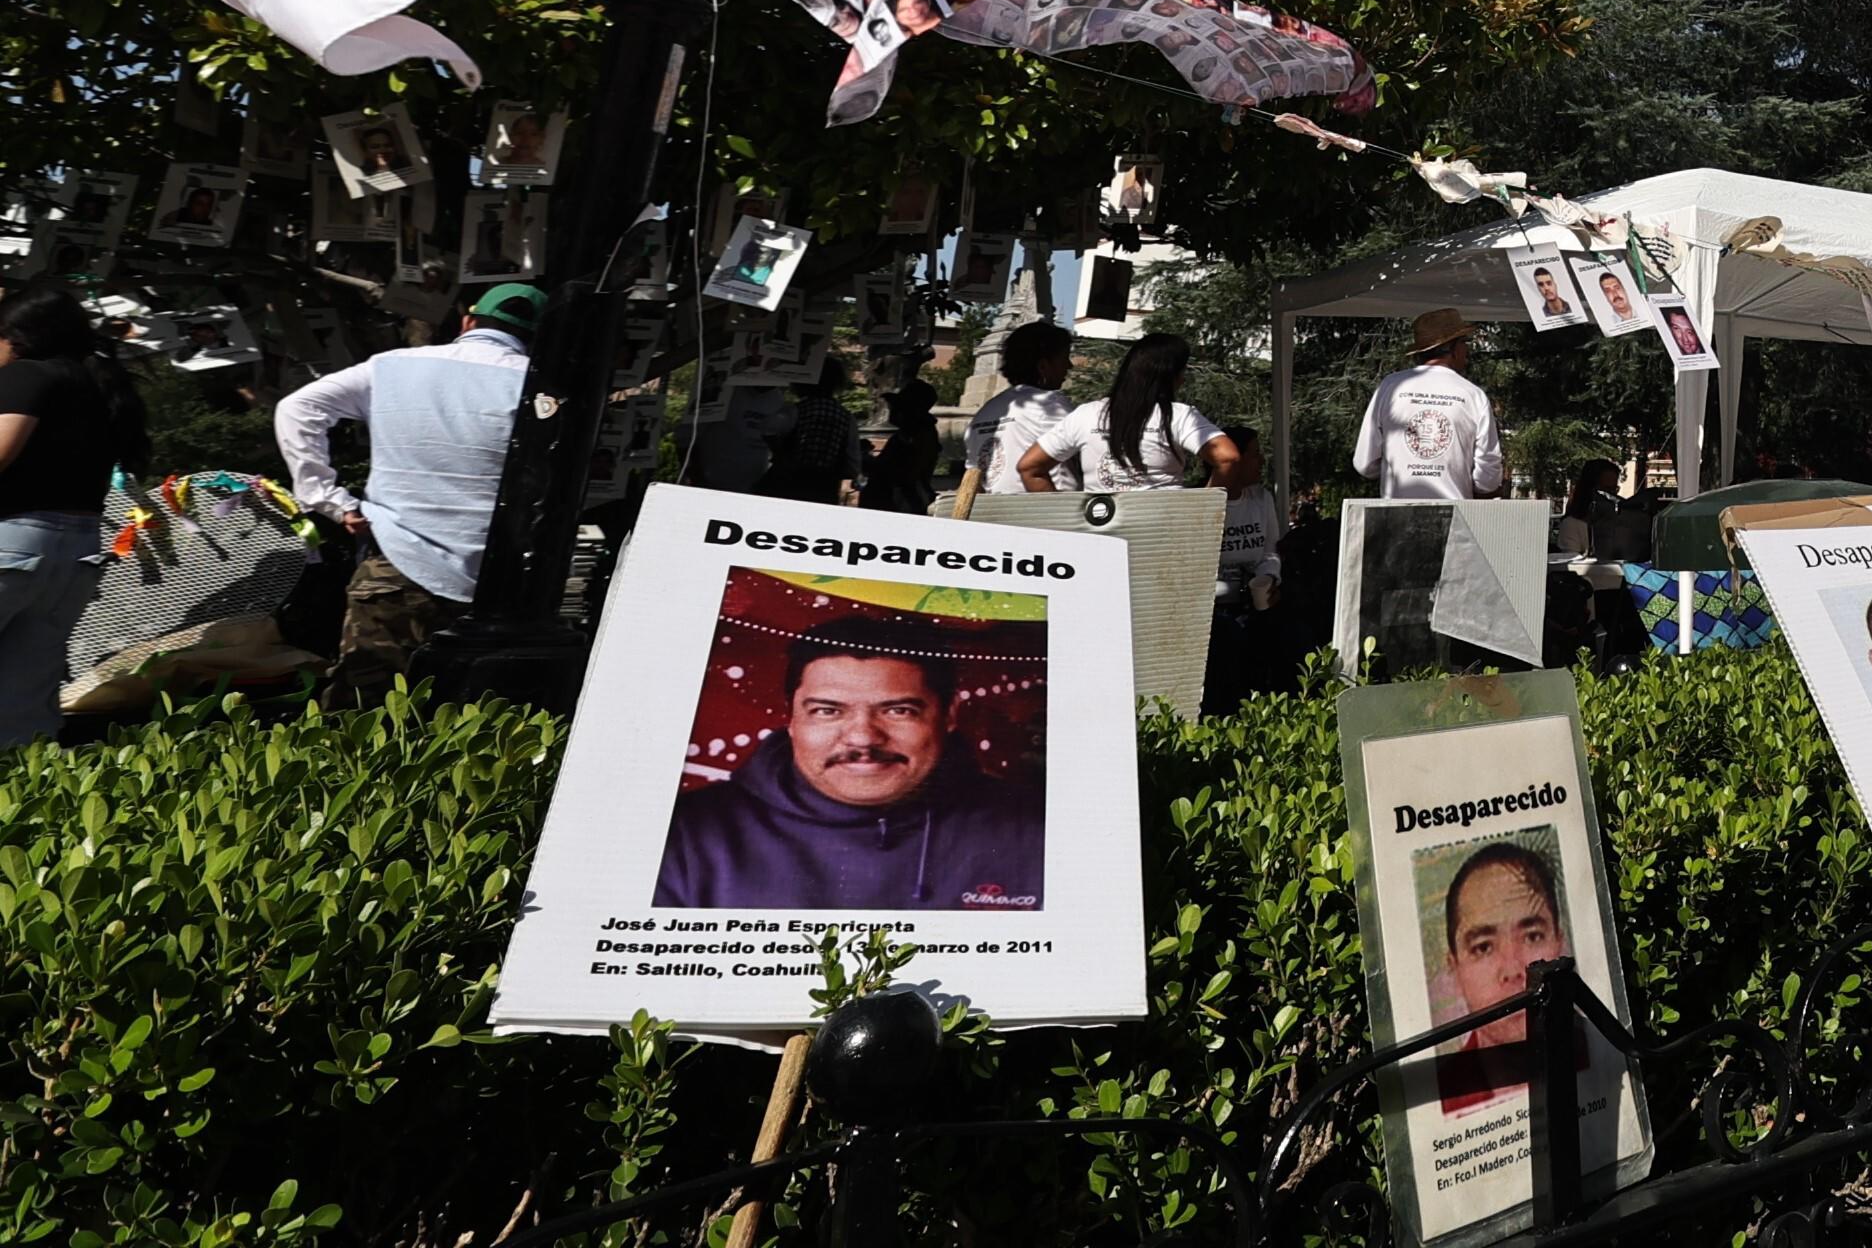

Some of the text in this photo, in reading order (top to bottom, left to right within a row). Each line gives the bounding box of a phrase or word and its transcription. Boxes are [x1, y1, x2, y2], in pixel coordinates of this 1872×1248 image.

[1514, 256, 1561, 268] DESAPARECIDO
[1223, 523, 1262, 536] ONDE
[704, 519, 1076, 580] Desaparecido
[1394, 782, 1567, 833] Desaparecido
[601, 918, 656, 932] José
[663, 919, 718, 932] Juan
[726, 919, 779, 932] Peña
[596, 940, 755, 956] Desaparecido
[762, 941, 824, 955] desd
[976, 940, 1000, 954] de
[1006, 940, 1053, 954] 2011
[590, 962, 627, 975] En:
[636, 963, 723, 979] Saltillo,
[1433, 1132, 1462, 1152] Sergio
[1464, 1114, 1512, 1141] Arredondo
[1435, 1138, 1497, 1172] Desaparecido
[1499, 1129, 1528, 1147] desde:
[1587, 1097, 1607, 1114] 2010
[1437, 1176, 1453, 1191] En:
[1479, 1154, 1514, 1175] Madero
